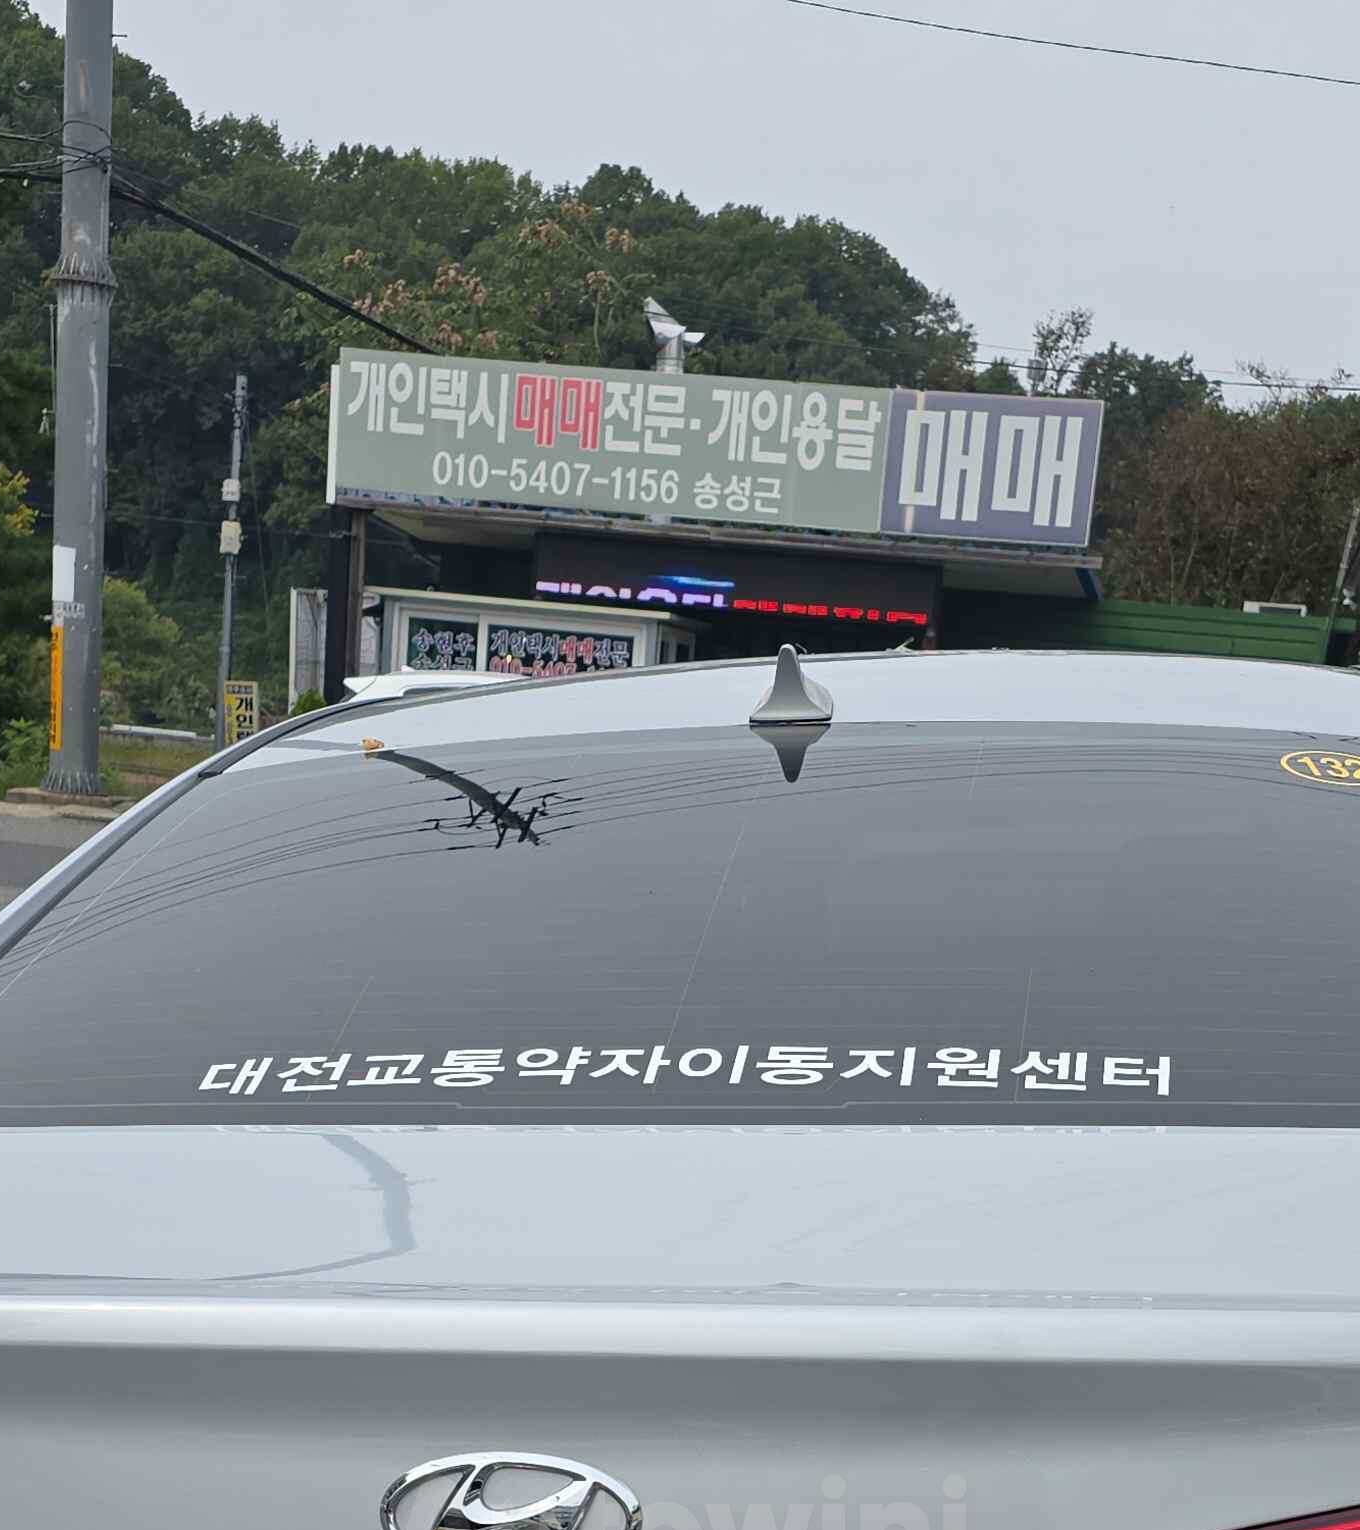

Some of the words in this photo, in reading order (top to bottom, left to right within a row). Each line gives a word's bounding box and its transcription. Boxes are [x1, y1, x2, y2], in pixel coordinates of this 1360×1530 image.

[432, 451, 679, 504] 010-5407-1156
[693, 471, 781, 514] 송성근
[898, 409, 1084, 528] 매매
[197, 1045, 1171, 1096] 대전교통약자이동지원센터
